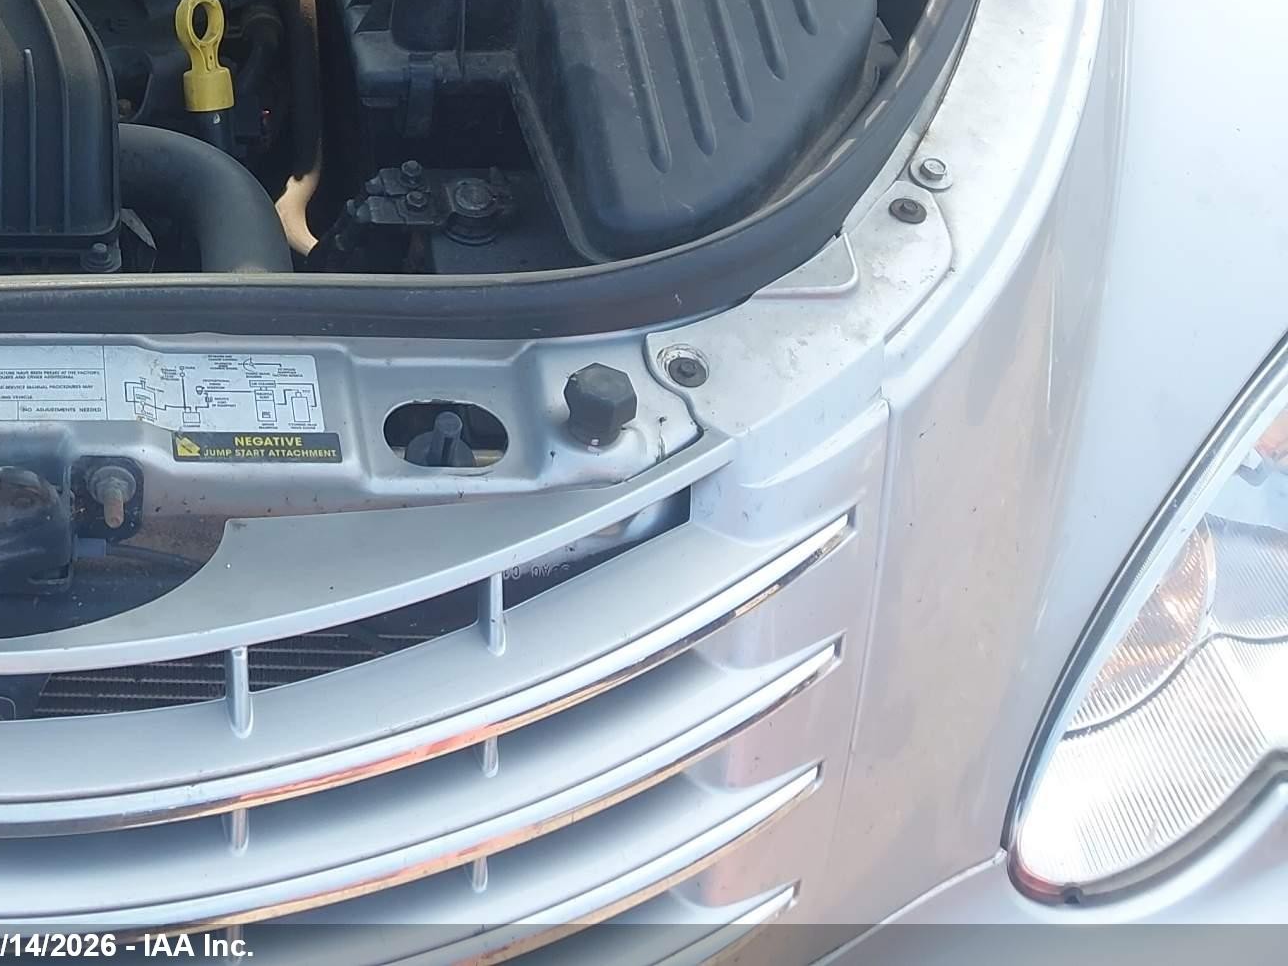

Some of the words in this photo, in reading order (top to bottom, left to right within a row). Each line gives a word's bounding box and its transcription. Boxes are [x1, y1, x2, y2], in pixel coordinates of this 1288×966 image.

[234, 436, 303, 447] NEGATIVE
[204, 449, 232, 457] JUMP
[235, 449, 265, 457] START
[268, 449, 337, 457] ATTACHMENT
